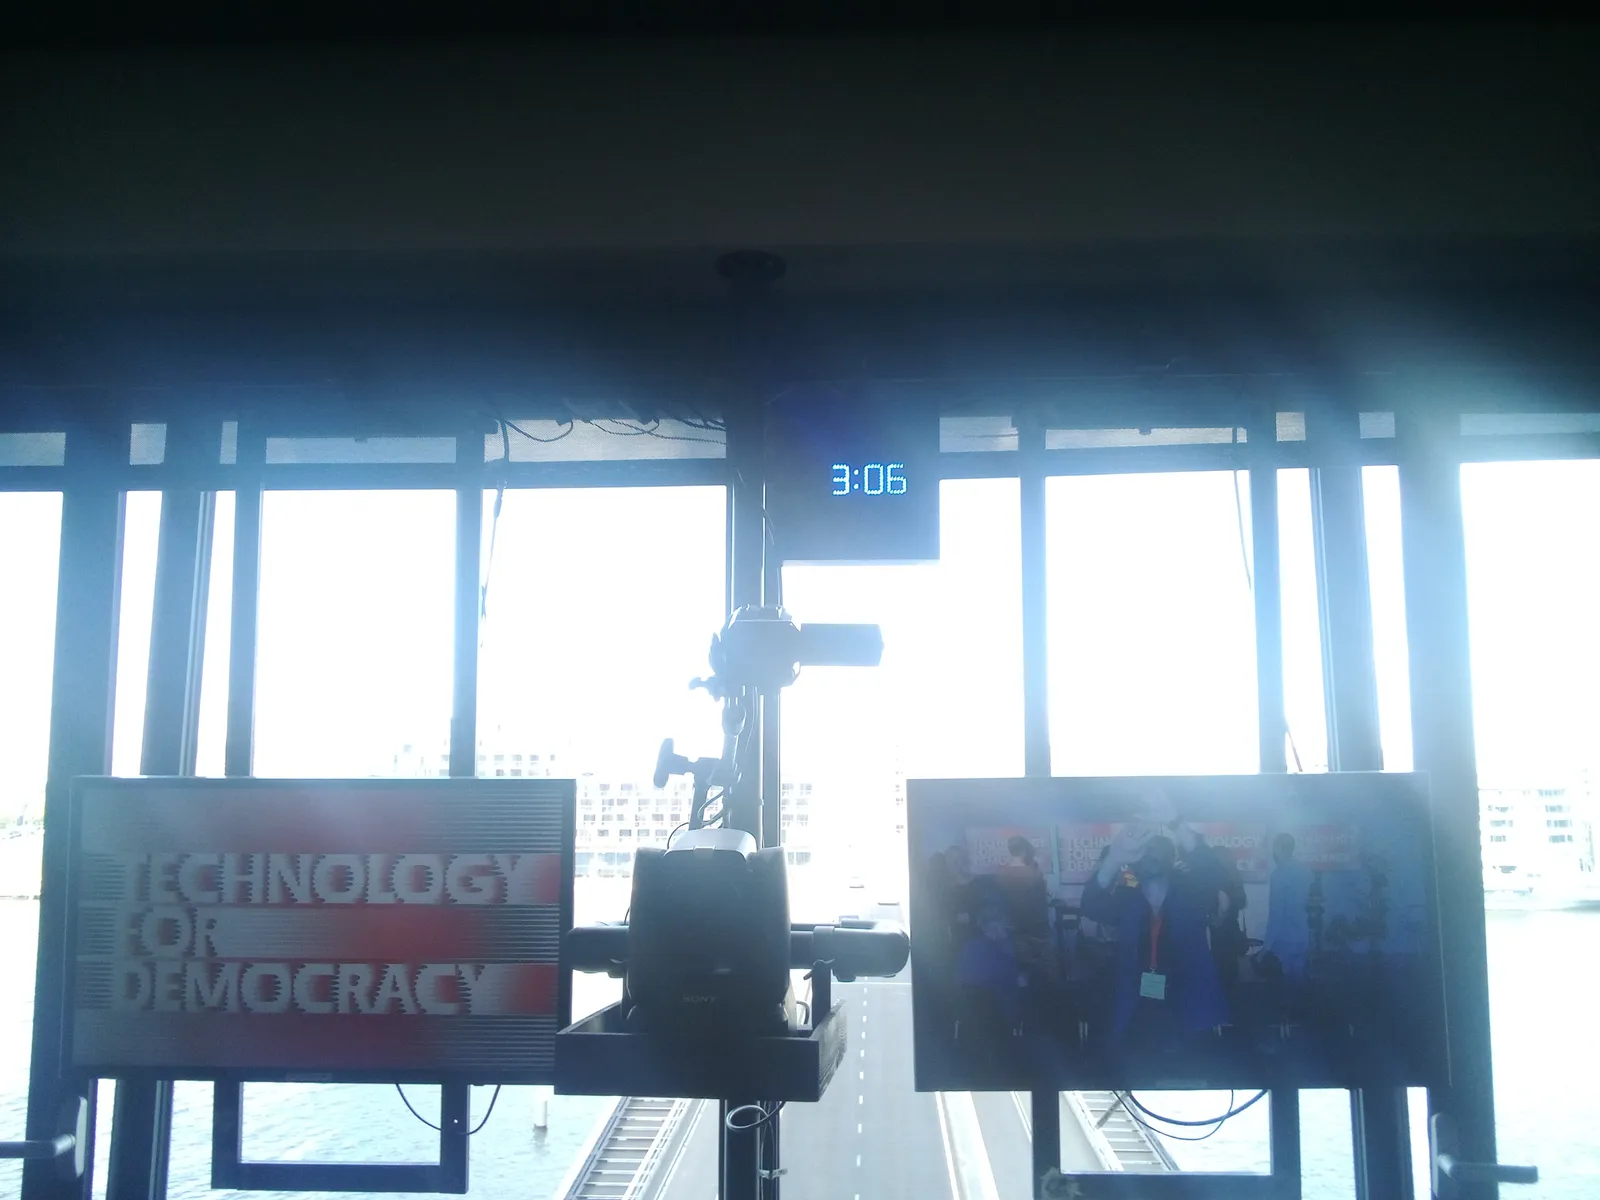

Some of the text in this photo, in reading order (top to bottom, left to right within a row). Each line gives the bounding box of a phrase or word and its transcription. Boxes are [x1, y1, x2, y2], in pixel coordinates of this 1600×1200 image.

[831, 462, 908, 496] 3:06
[126, 852, 522, 904] TECHNOLOGY
[120, 906, 219, 959] FOR
[120, 962, 487, 1016] DEMOCRACY
